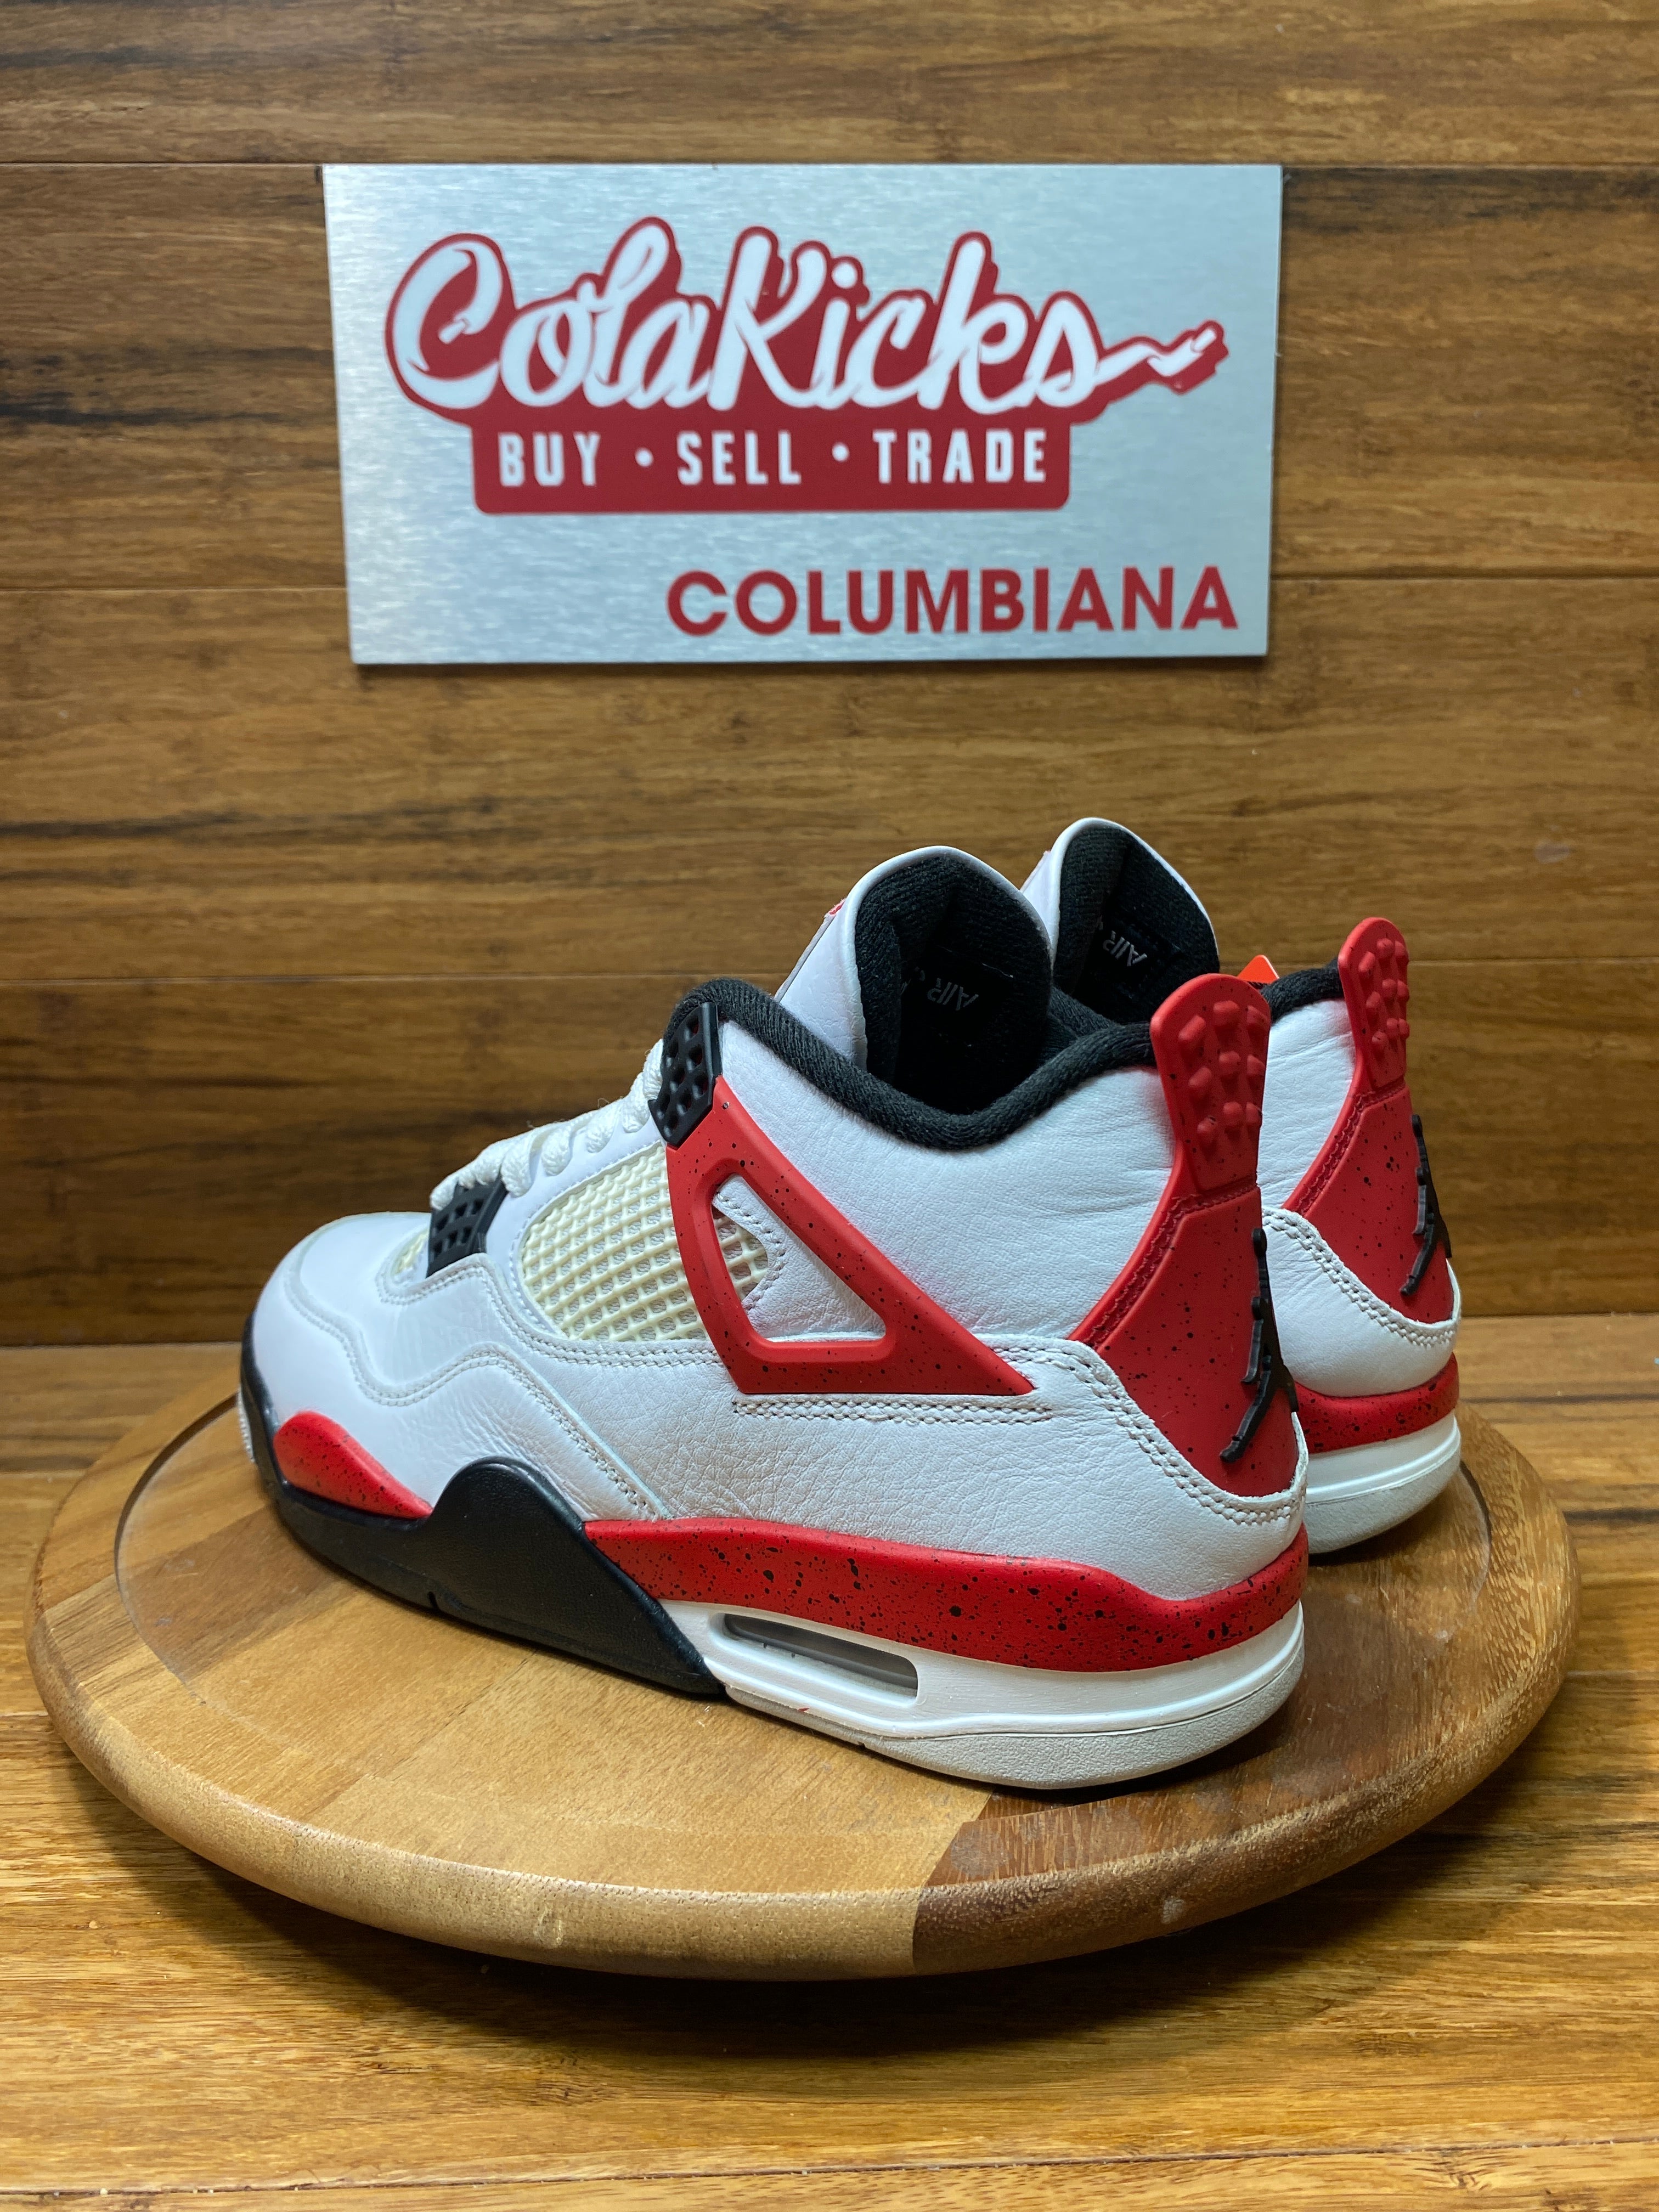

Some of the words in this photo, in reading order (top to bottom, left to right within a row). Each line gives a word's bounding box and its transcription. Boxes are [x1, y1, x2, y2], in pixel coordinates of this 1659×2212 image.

[390, 218, 1220, 416] ColaKicks
[498, 431, 601, 487] BUY
[676, 430, 802, 486] SELL
[872, 428, 1047, 484] TRADE
[667, 566, 1237, 636] COLUMBIANA
[1102, 930, 1148, 967] AIR
[927, 977, 979, 1012] AIR
